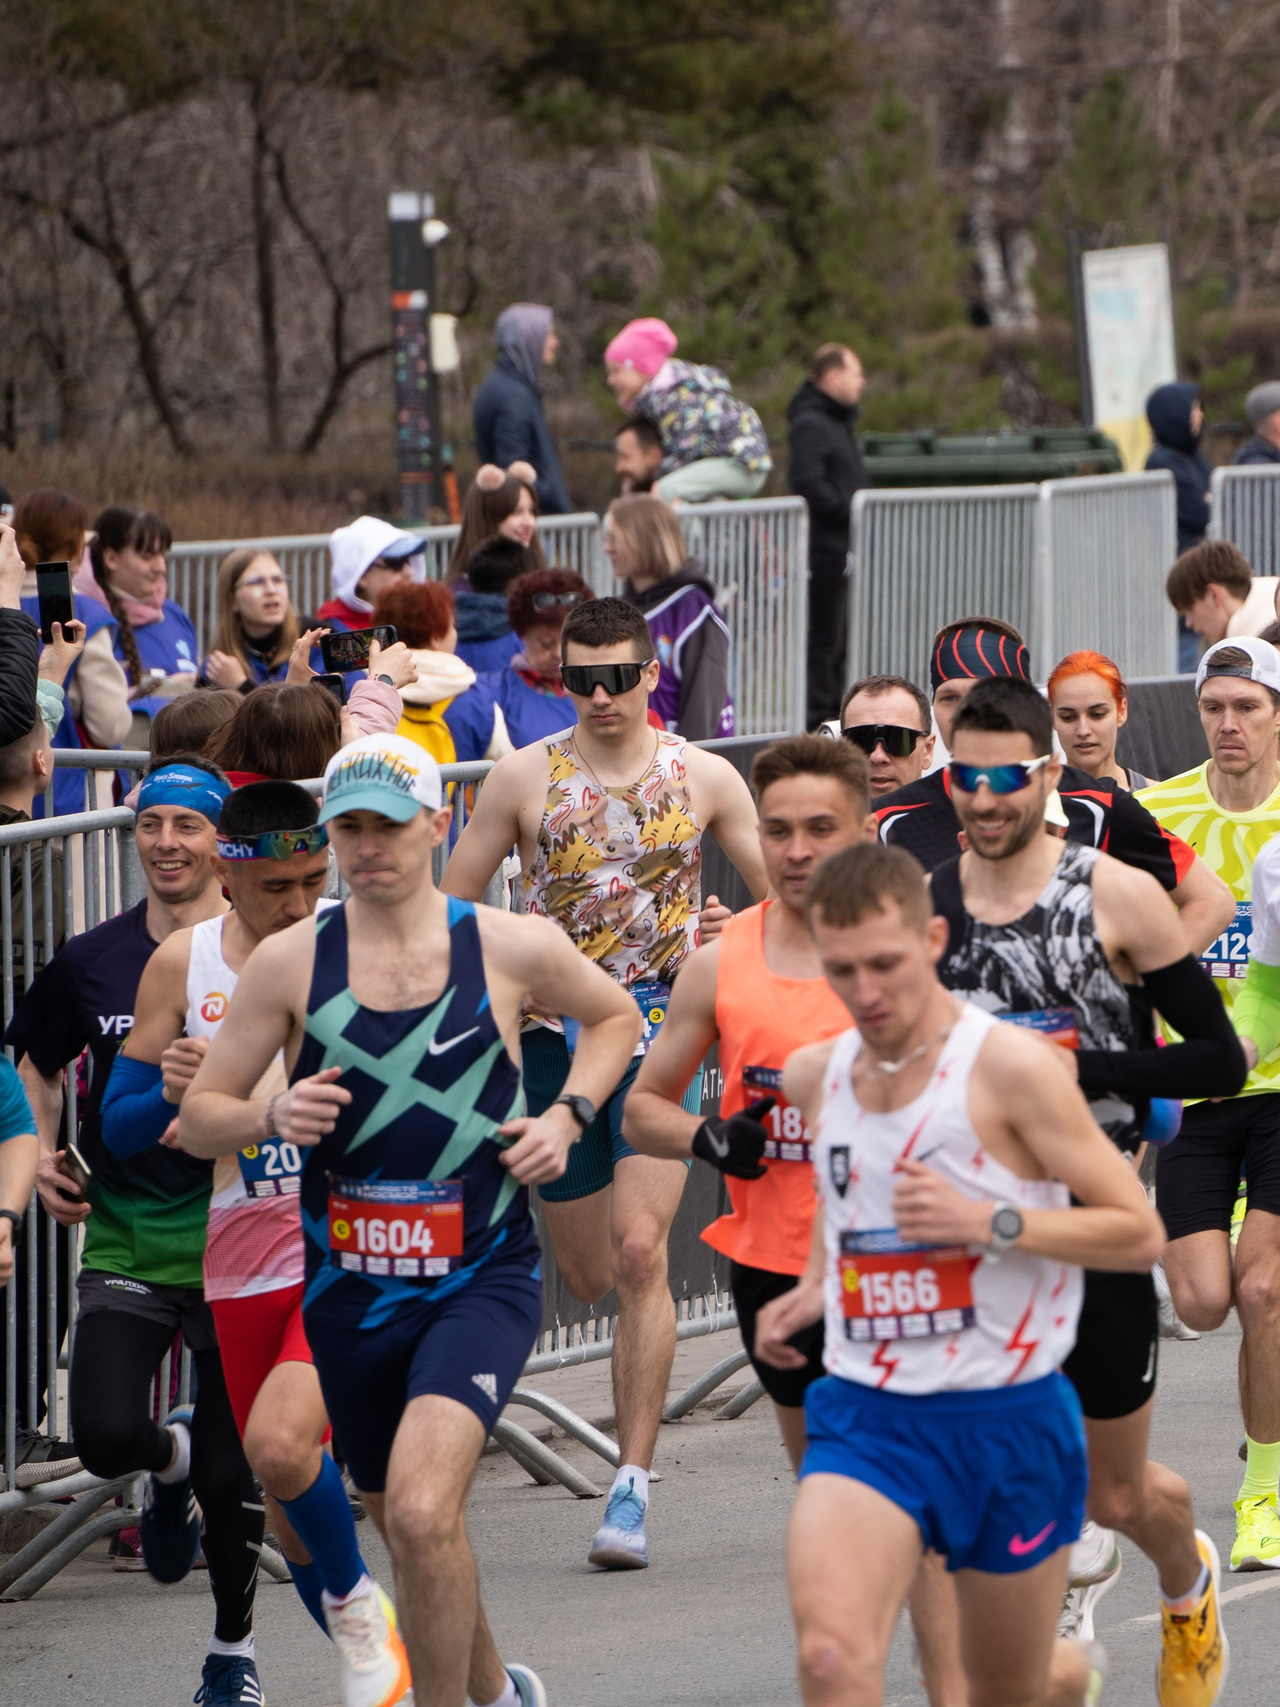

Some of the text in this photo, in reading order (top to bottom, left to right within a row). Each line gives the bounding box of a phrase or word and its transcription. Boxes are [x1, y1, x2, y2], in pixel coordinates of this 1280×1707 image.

[98, 1014, 135, 1035] УР
[768, 1104, 812, 1140] 18
[261, 1142, 302, 1176] 20
[353, 1218, 434, 1255] 1604
[859, 1268, 940, 1315] 1566
